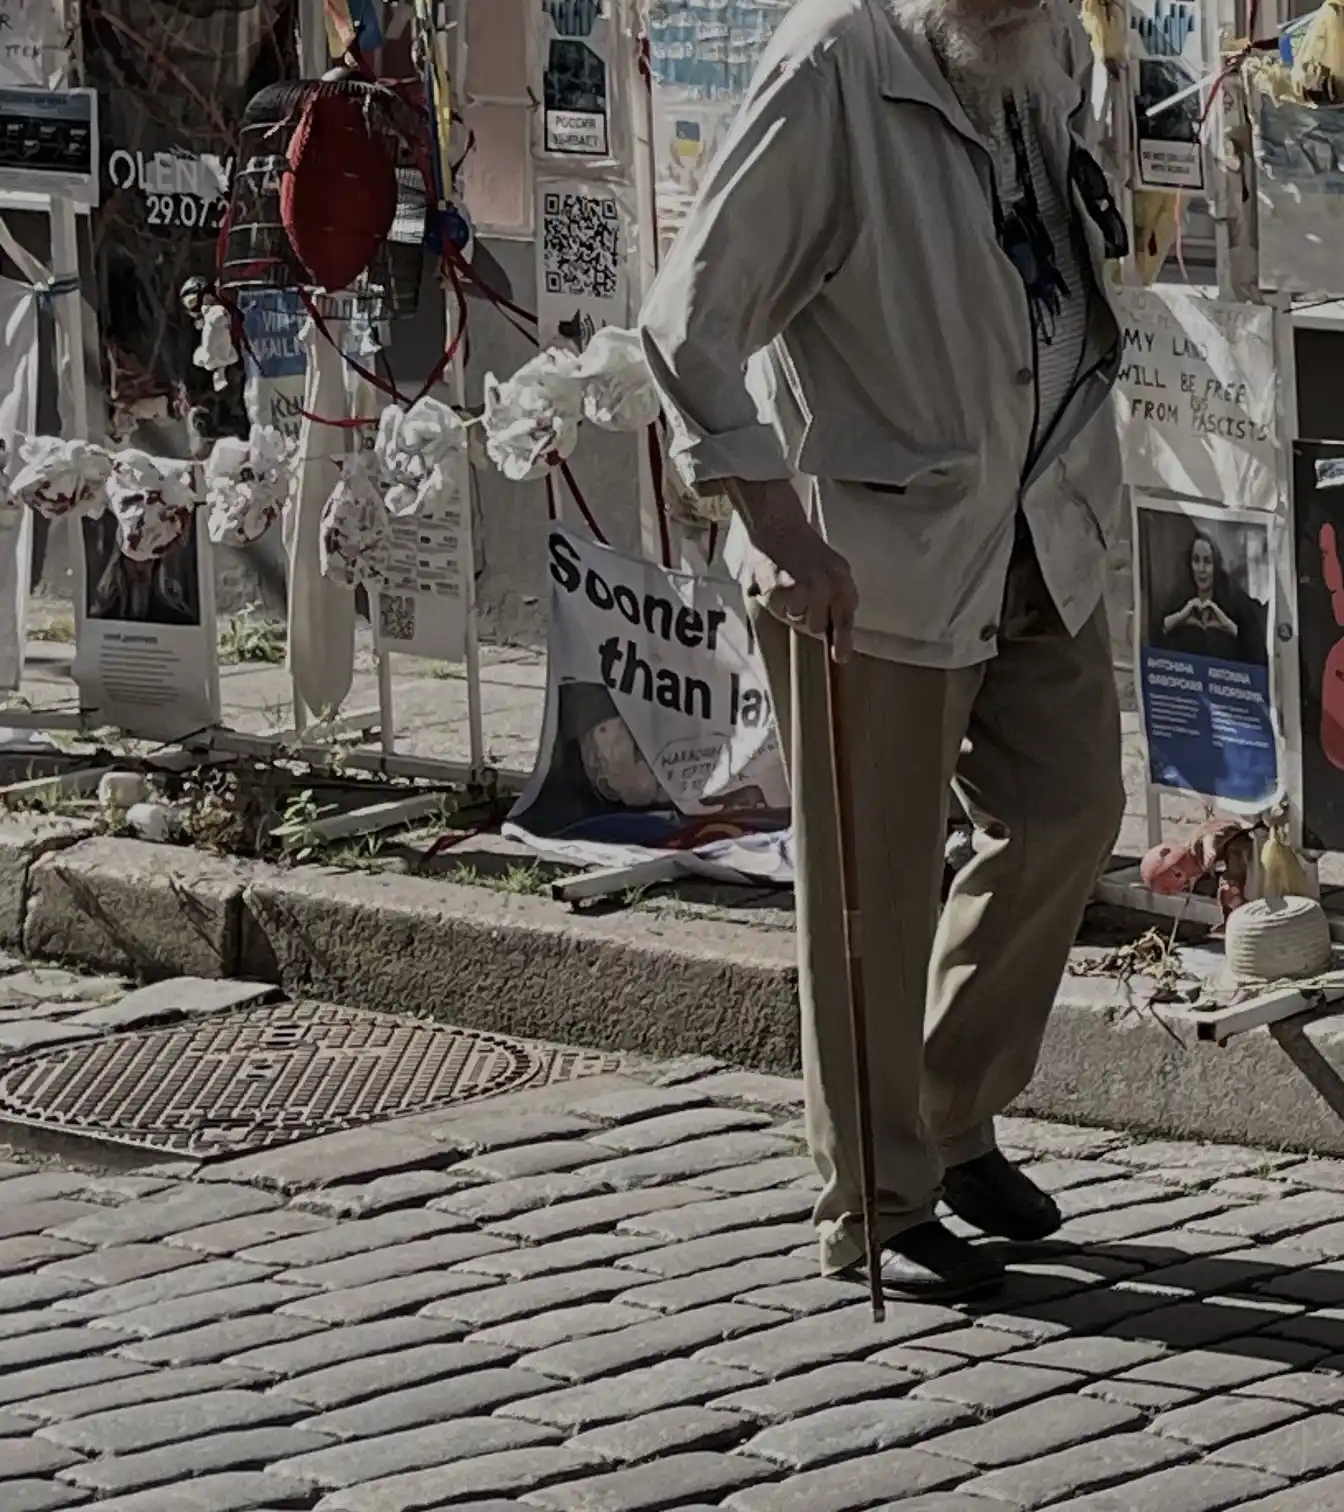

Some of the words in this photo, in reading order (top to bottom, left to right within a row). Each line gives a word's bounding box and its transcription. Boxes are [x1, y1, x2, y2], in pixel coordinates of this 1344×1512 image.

[1122, 327, 1156, 354] MY
[1117, 363, 1168, 390] WILL
[1179, 370, 1198, 394] BE
[1205, 377, 1248, 405] FREE
[1130, 398, 1180, 426] FROM
[548, 532, 727, 651] Sooner
[598, 636, 712, 721] than
[729, 672, 772, 730] la
